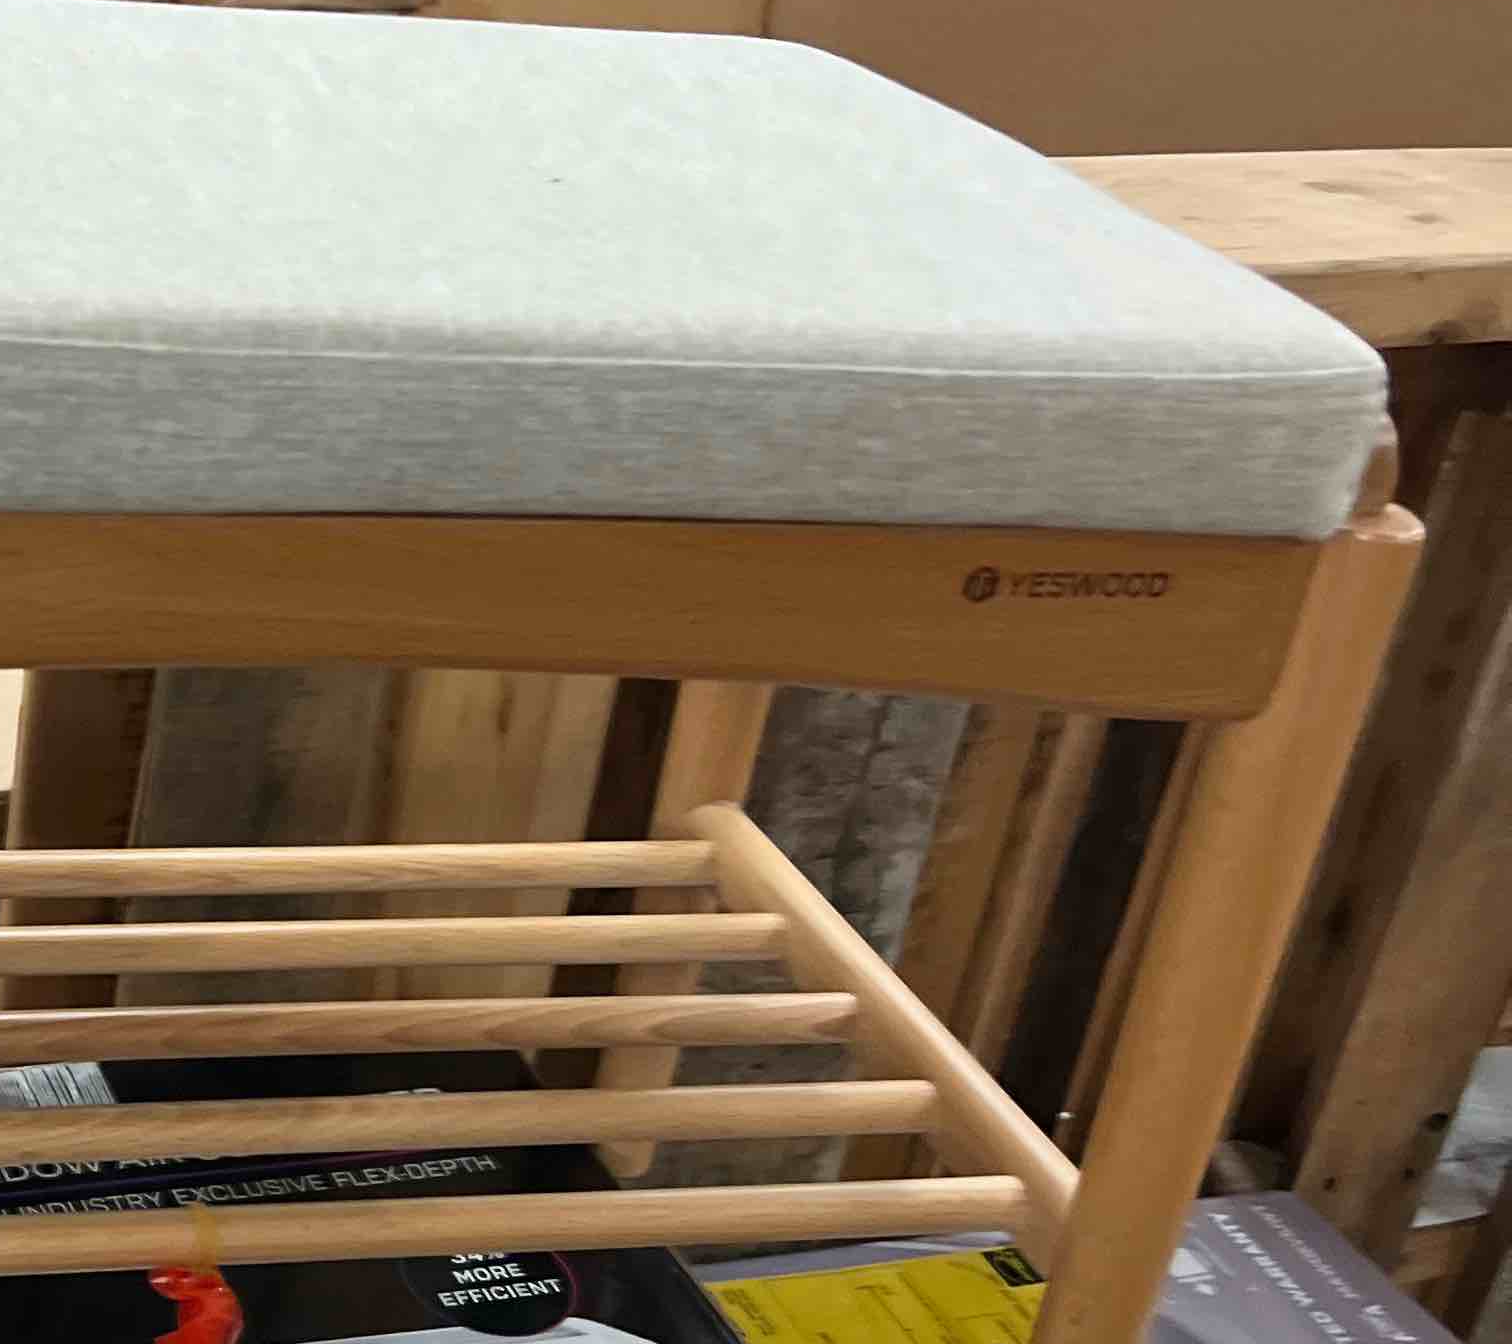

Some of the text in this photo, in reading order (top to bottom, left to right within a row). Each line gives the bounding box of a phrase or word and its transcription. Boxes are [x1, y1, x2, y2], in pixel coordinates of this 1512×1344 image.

[1008, 570, 1173, 601] YESWOOD
[172, 1173, 328, 1208] EXCLUSIVE
[331, 1153, 498, 1188] FLEX-DEPTH
[452, 1263, 528, 1285] MORE
[438, 1279, 561, 1307] EFFICIENT
